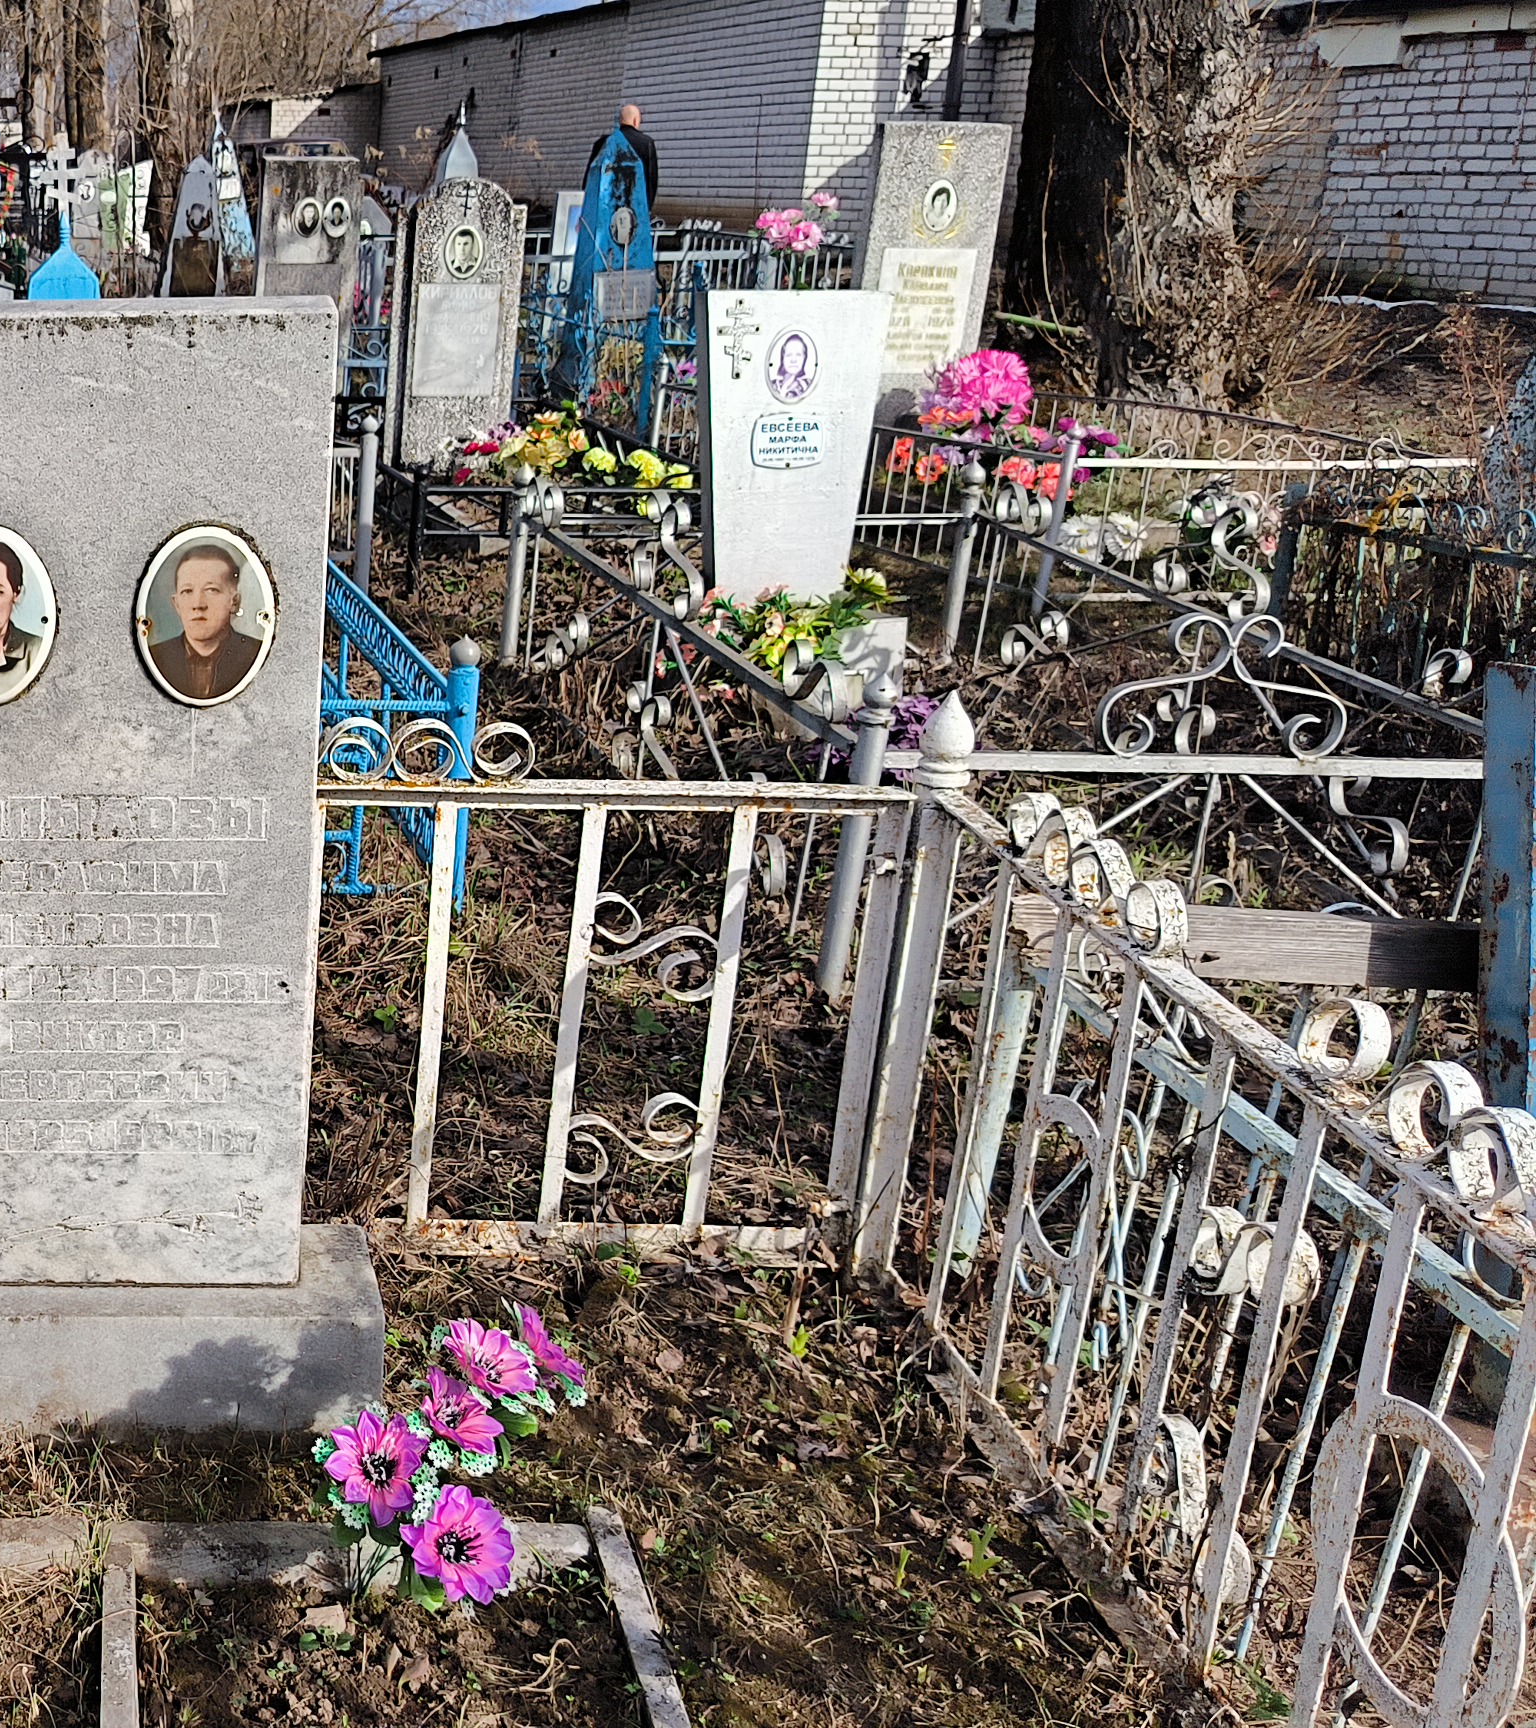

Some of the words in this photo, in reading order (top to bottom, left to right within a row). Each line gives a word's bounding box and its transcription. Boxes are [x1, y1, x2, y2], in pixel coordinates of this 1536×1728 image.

[761, 422, 819, 433] ЕВСЕЕВА
[769, 435, 807, 443] МАРФА
[758, 446, 819, 455] НИКИТИЧНА
[10, 1021, 184, 1052] ВИКТОР
